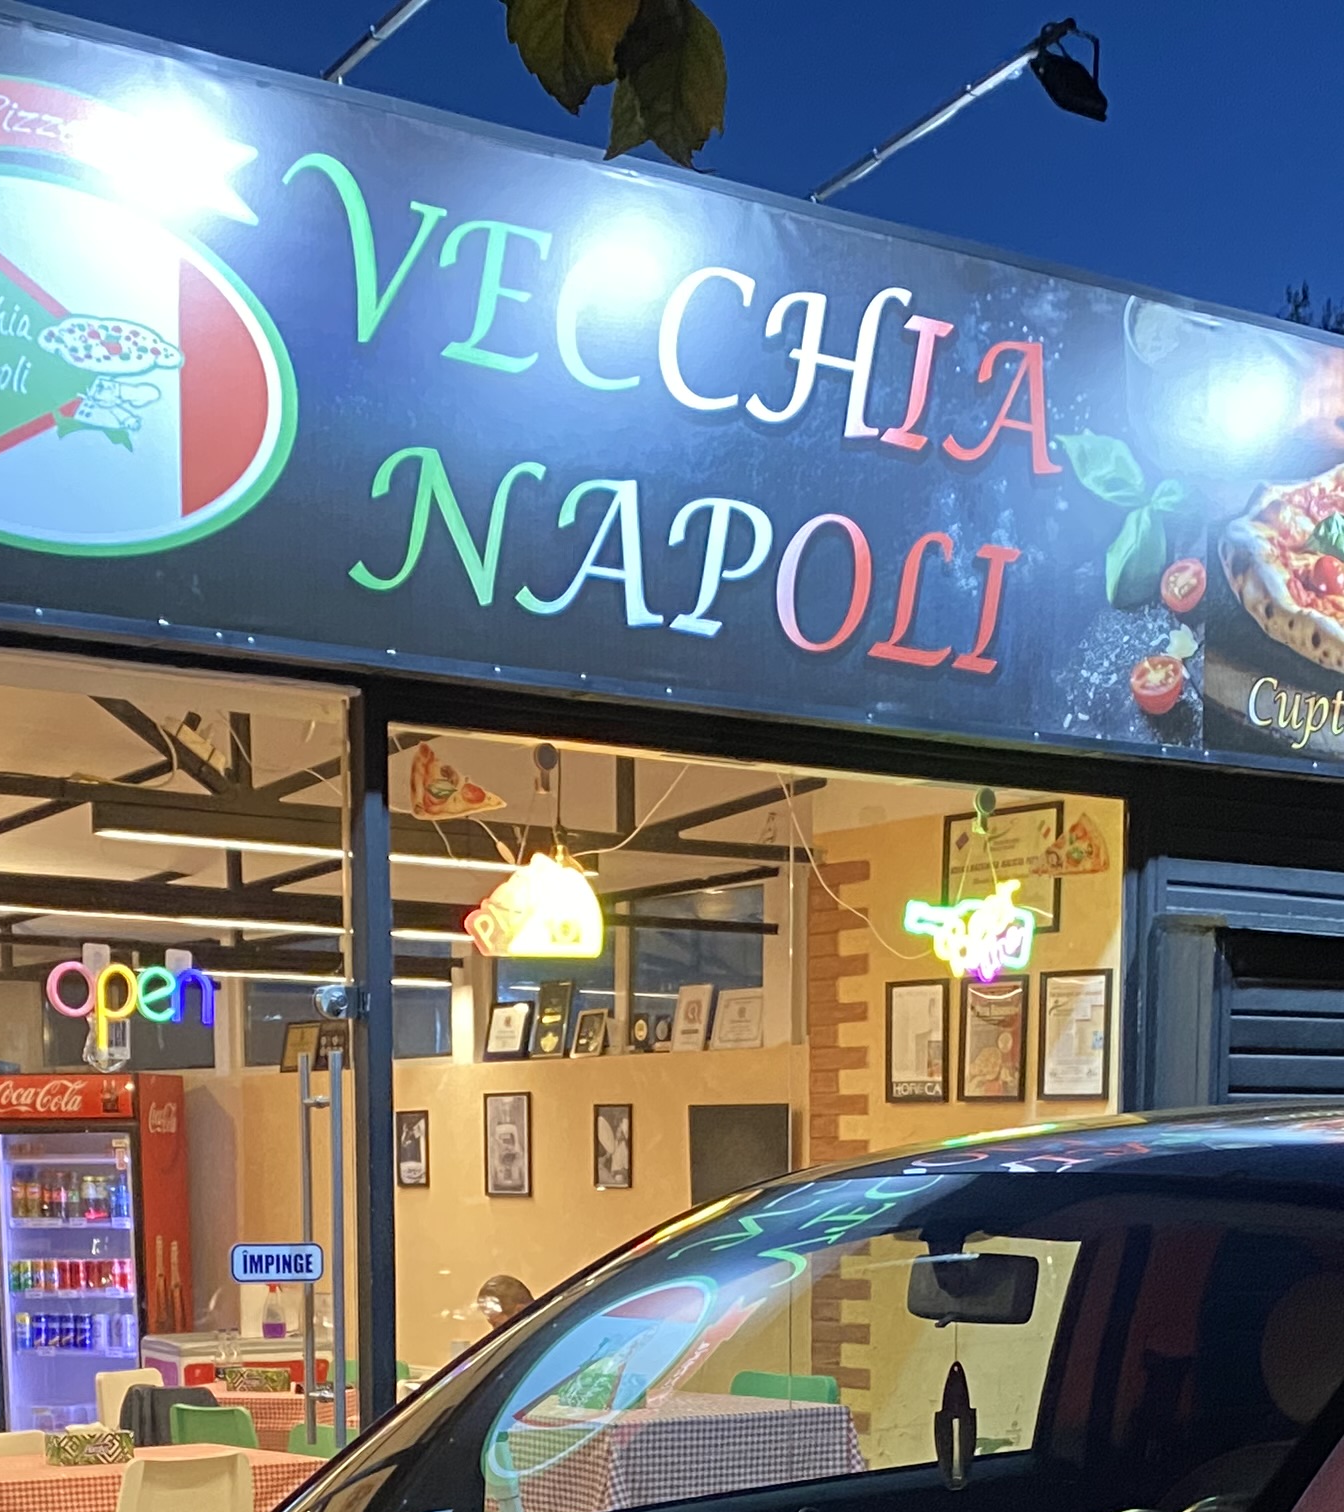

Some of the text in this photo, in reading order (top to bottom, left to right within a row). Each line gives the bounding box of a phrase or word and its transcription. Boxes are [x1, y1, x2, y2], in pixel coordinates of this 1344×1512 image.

[281, 152, 1063, 476] VECCHIA
[348, 445, 1023, 675] NAPOLI
[46, 961, 215, 1054] open
[242, 1250, 314, 1275] ÎMPINGE
